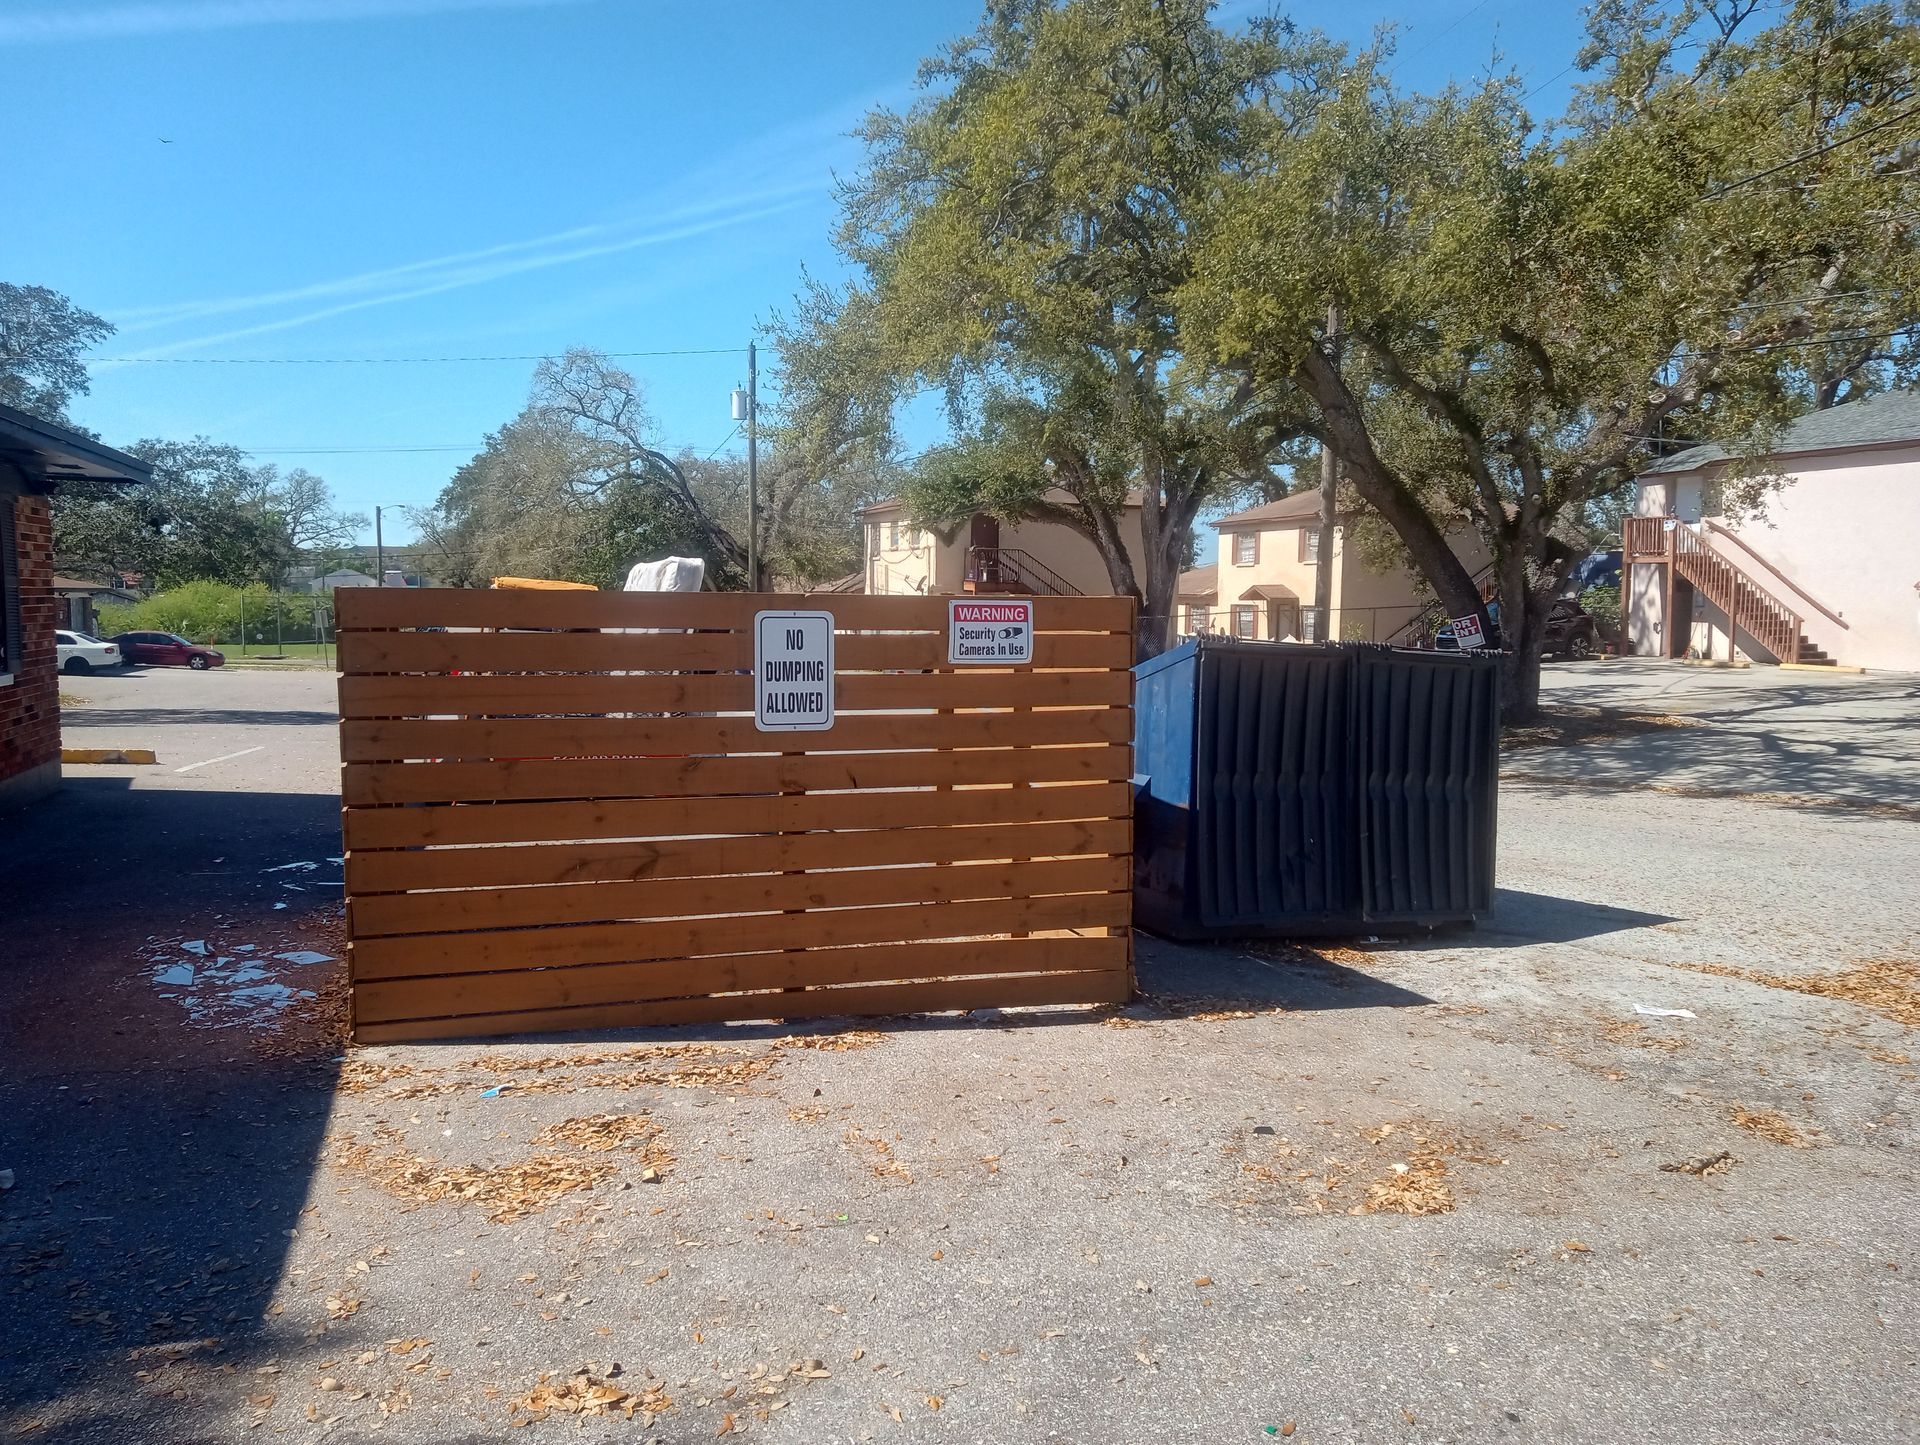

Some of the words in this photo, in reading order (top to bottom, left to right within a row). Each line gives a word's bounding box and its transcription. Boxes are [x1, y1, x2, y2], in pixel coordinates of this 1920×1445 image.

[958, 607, 1025, 621] WARNING
[786, 629, 804, 651] NO
[959, 627, 996, 642] Security
[959, 643, 996, 656] Cameras
[998, 643, 1006, 655] In
[1008, 642, 1024, 655] Use
[765, 660, 824, 682] DUMPING
[766, 691, 823, 714] ALLOWED
